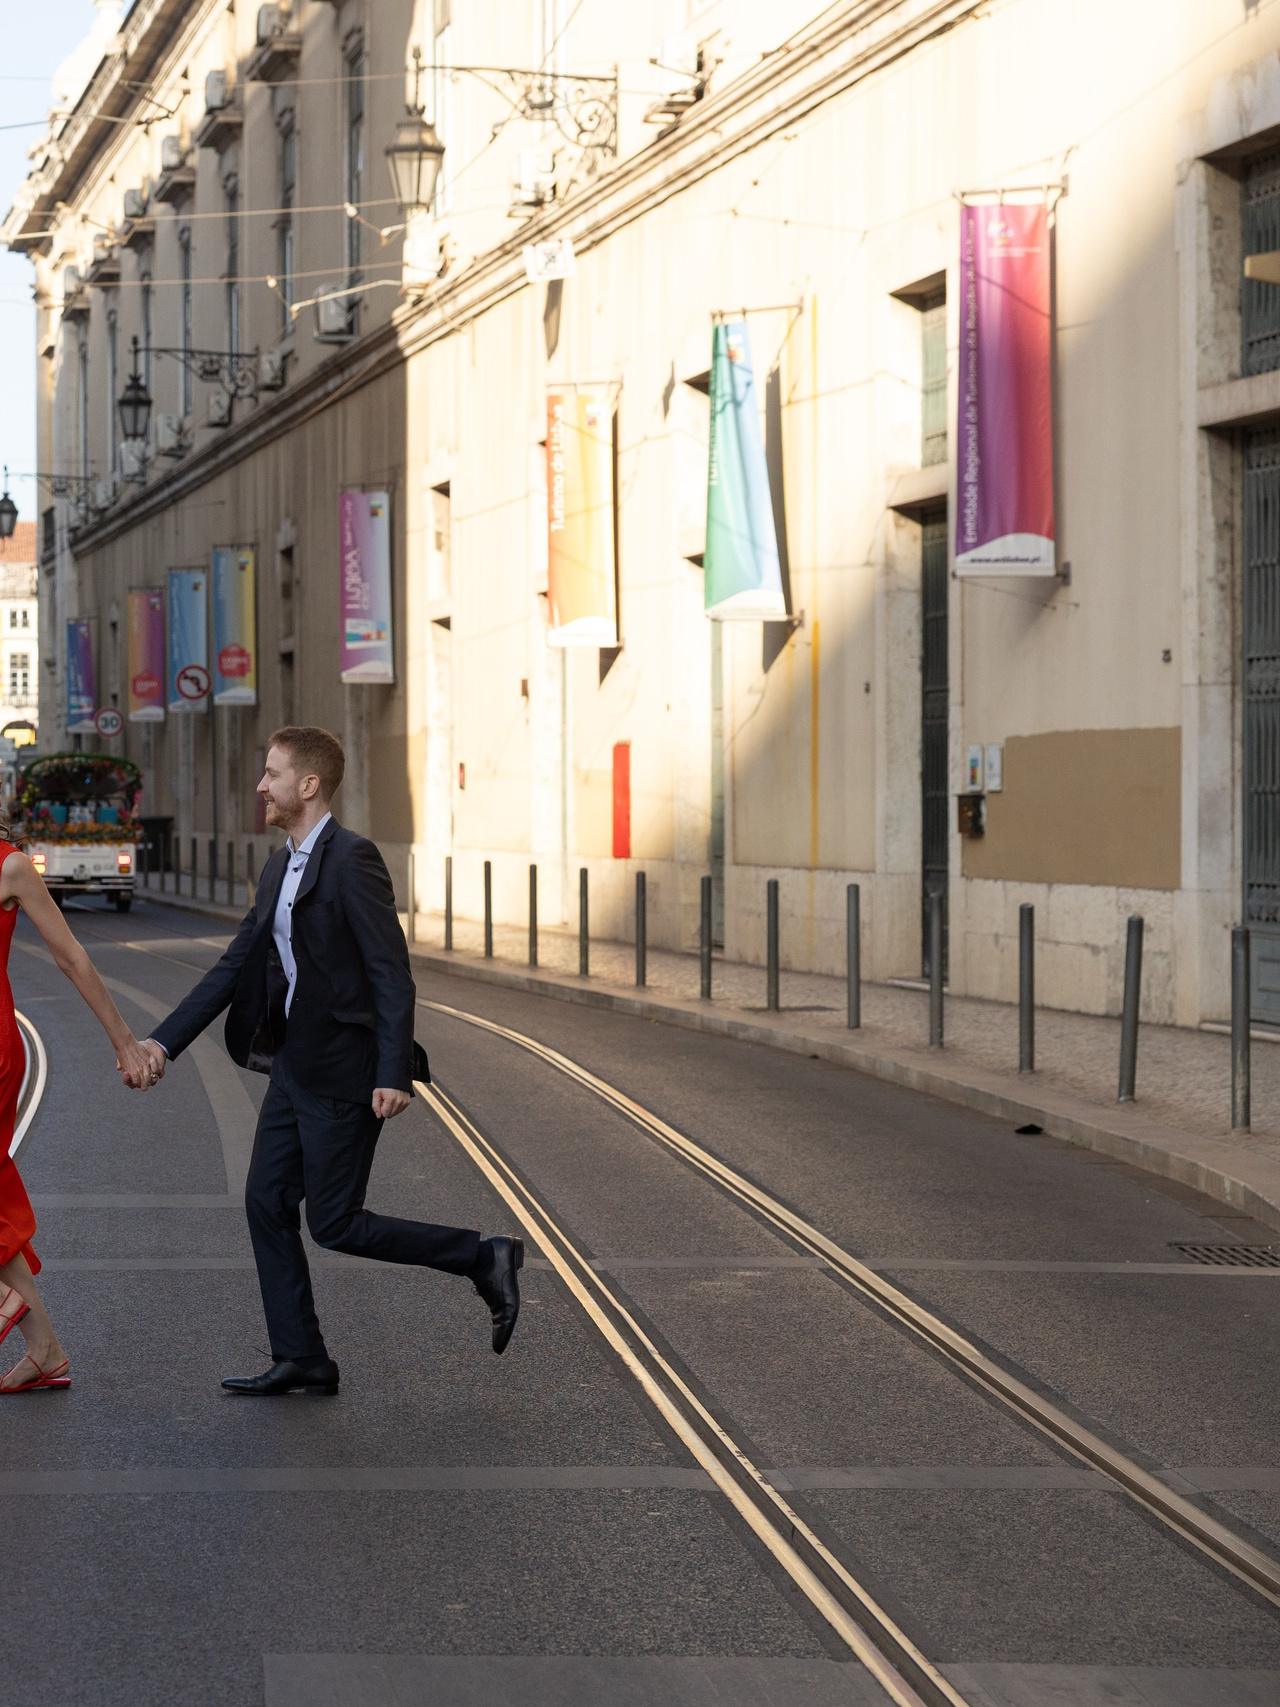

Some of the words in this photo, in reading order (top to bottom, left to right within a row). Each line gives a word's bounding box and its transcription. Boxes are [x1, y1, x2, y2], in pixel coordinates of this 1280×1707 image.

[965, 351, 978, 403] Turismo
[550, 404, 564, 451] Lisboa
[963, 424, 980, 482] Regional
[550, 453, 565, 472] de
[550, 474, 565, 532] Turismo
[963, 484, 978, 543] Entidade
[101, 716, 119, 729] 30
